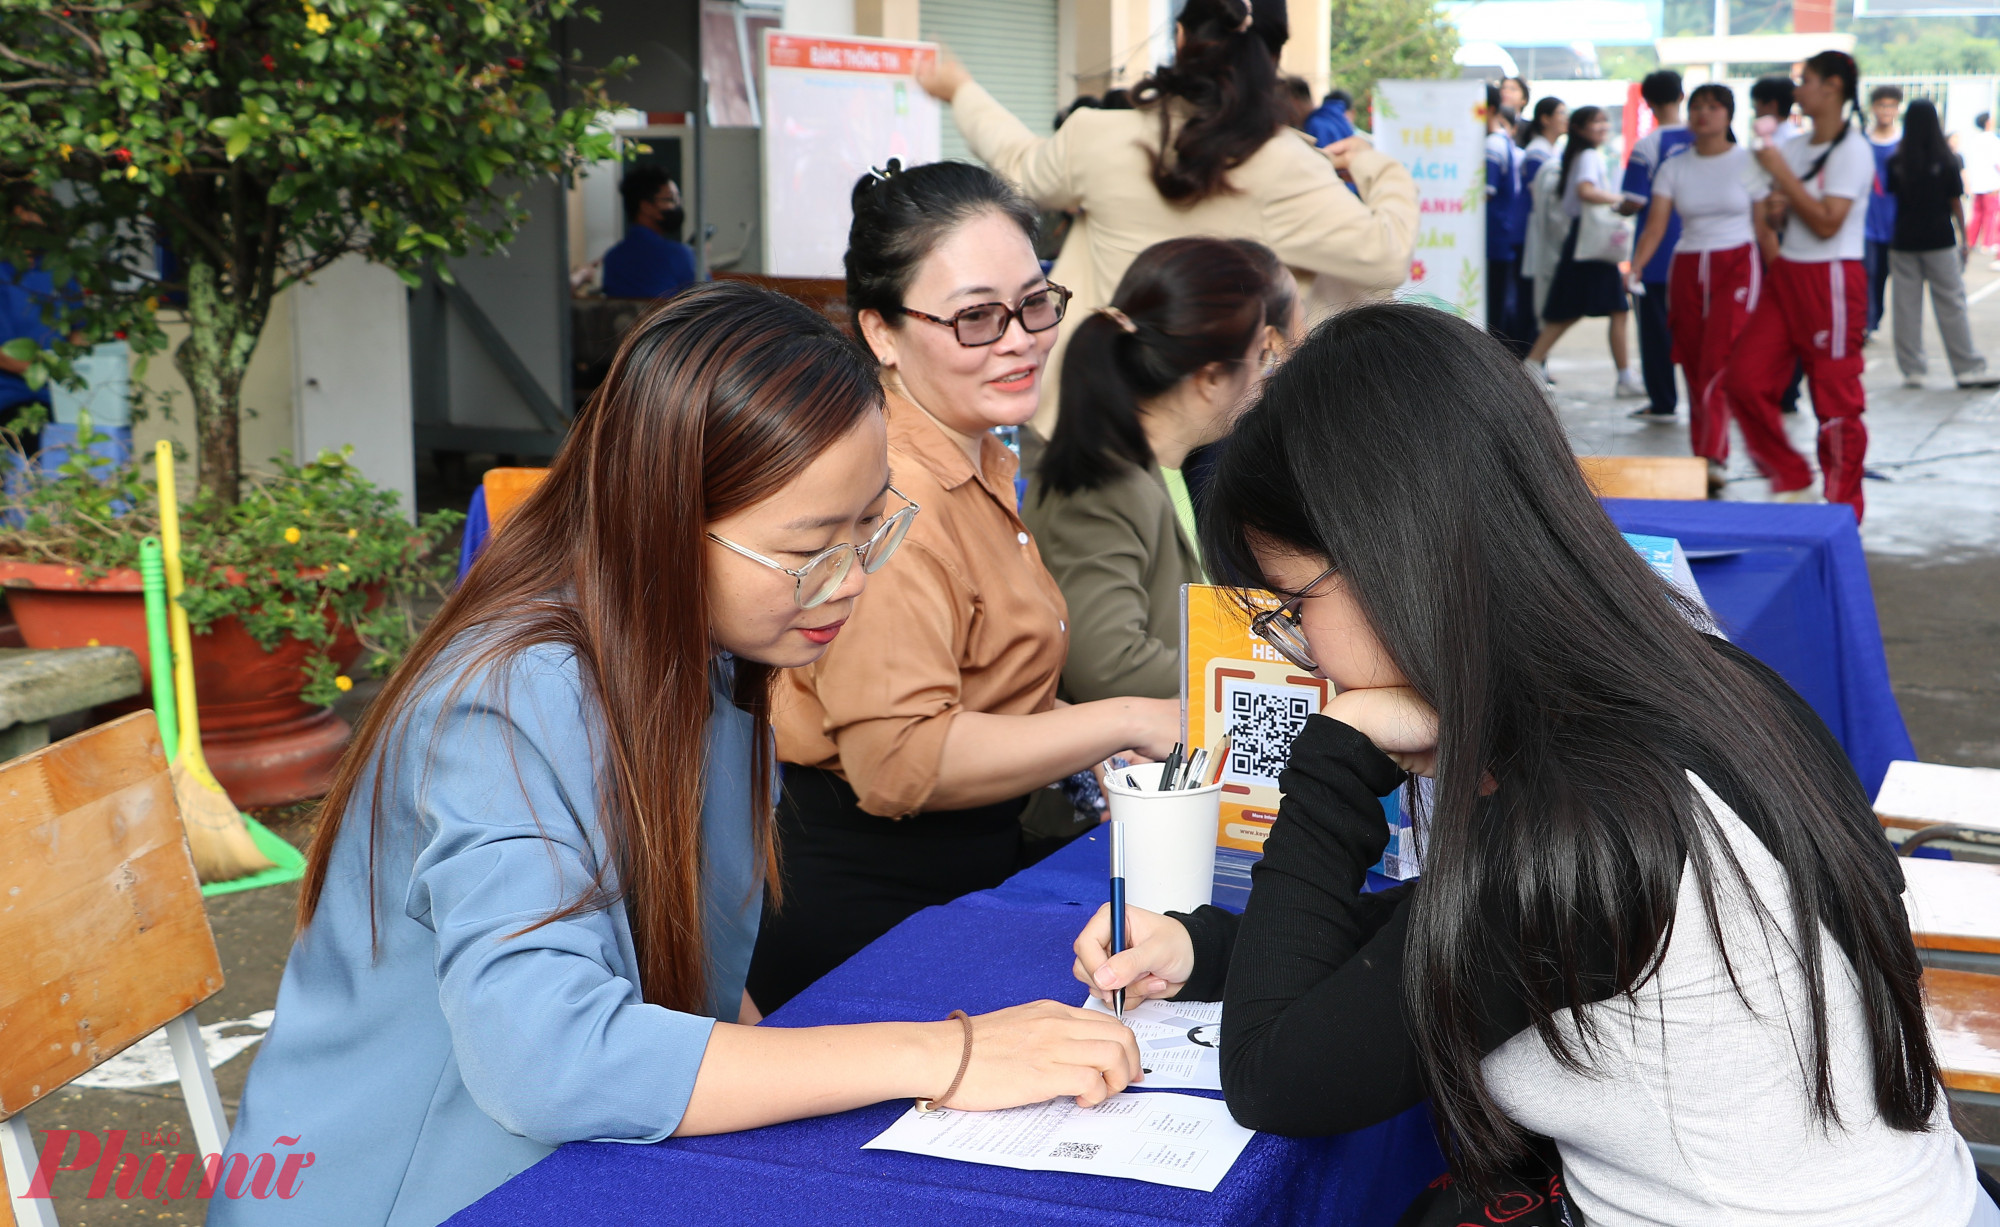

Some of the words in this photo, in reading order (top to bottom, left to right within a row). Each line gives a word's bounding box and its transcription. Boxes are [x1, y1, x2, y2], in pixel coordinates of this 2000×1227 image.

[1401, 125, 1454, 149] TIỆM
[1404, 157, 1458, 179] ÁCH
[1420, 197, 1463, 213] ANH
[1252, 643, 1291, 662] HER
